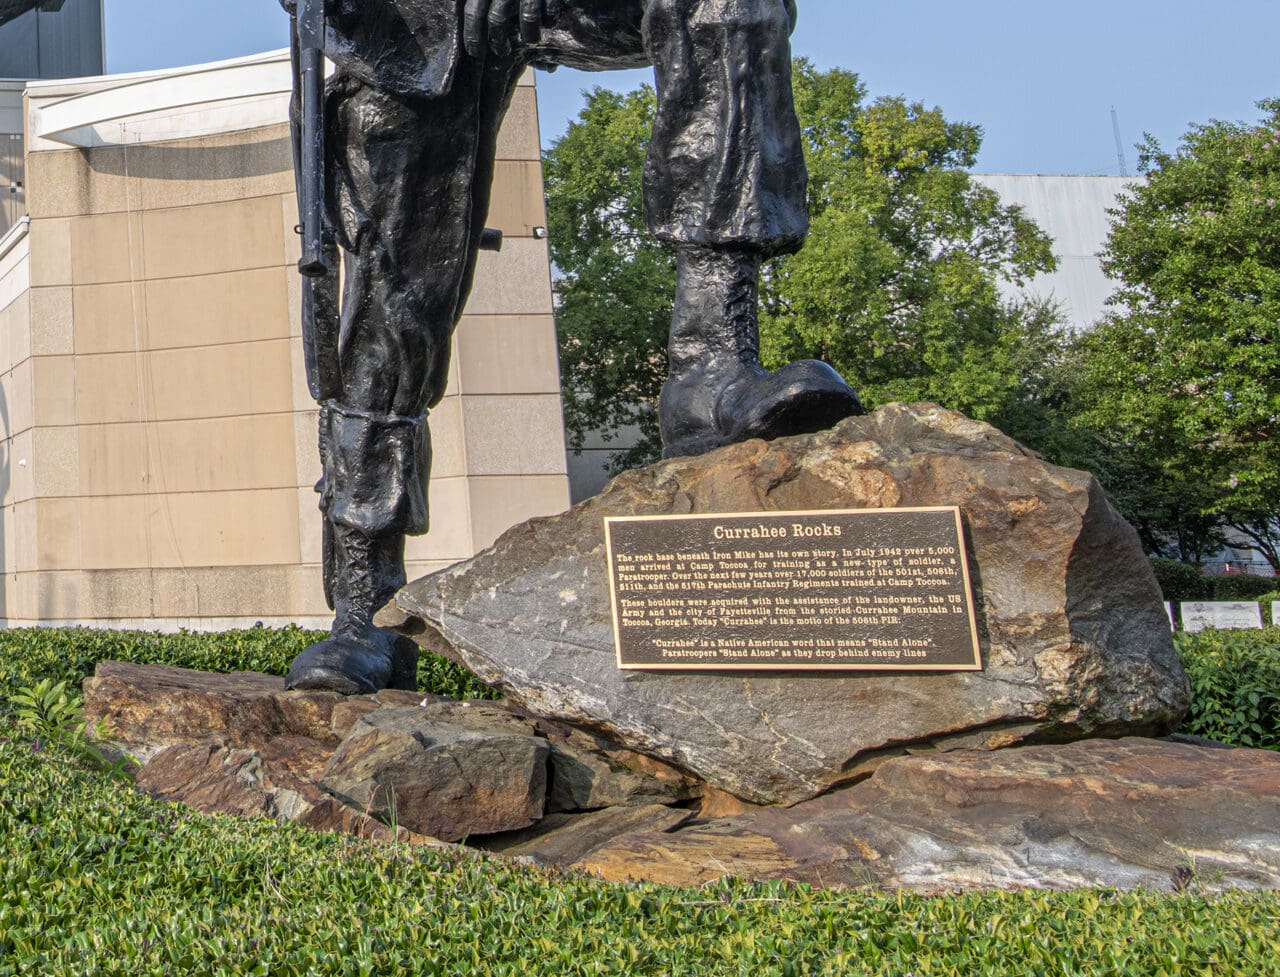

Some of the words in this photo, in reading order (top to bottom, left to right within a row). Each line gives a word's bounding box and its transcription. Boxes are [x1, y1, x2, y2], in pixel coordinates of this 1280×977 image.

[714, 524, 786, 539] Currahee
[792, 523, 841, 537] Rocks
[617, 554, 632, 562] The
[812, 550, 839, 558] story.
[855, 549, 875, 557] July
[928, 547, 954, 556] 5,000
[690, 562, 713, 571] Camp
[773, 560, 810, 568] training
[868, 559, 887, 567] type
[909, 558, 944, 566] soldier,
[619, 573, 669, 582] Paratrooper.
[797, 570, 825, 578] 17,000
[896, 568, 924, 576] 501st,
[753, 580, 790, 589] Infantry
[793, 580, 839, 588] Regiments
[889, 578, 913, 587] Camp
[711, 598, 748, 607] acquired
[843, 596, 852, 604] of
[874, 596, 925, 604] landowner,
[622, 609, 645, 617] Army
[687, 608, 703, 616] city
[693, 618, 717, 626] Today
[663, 650, 717, 658] Paratroopers
[794, 650, 812, 658] they
[816, 650, 836, 658] drop
[872, 650, 901, 658] enemy
